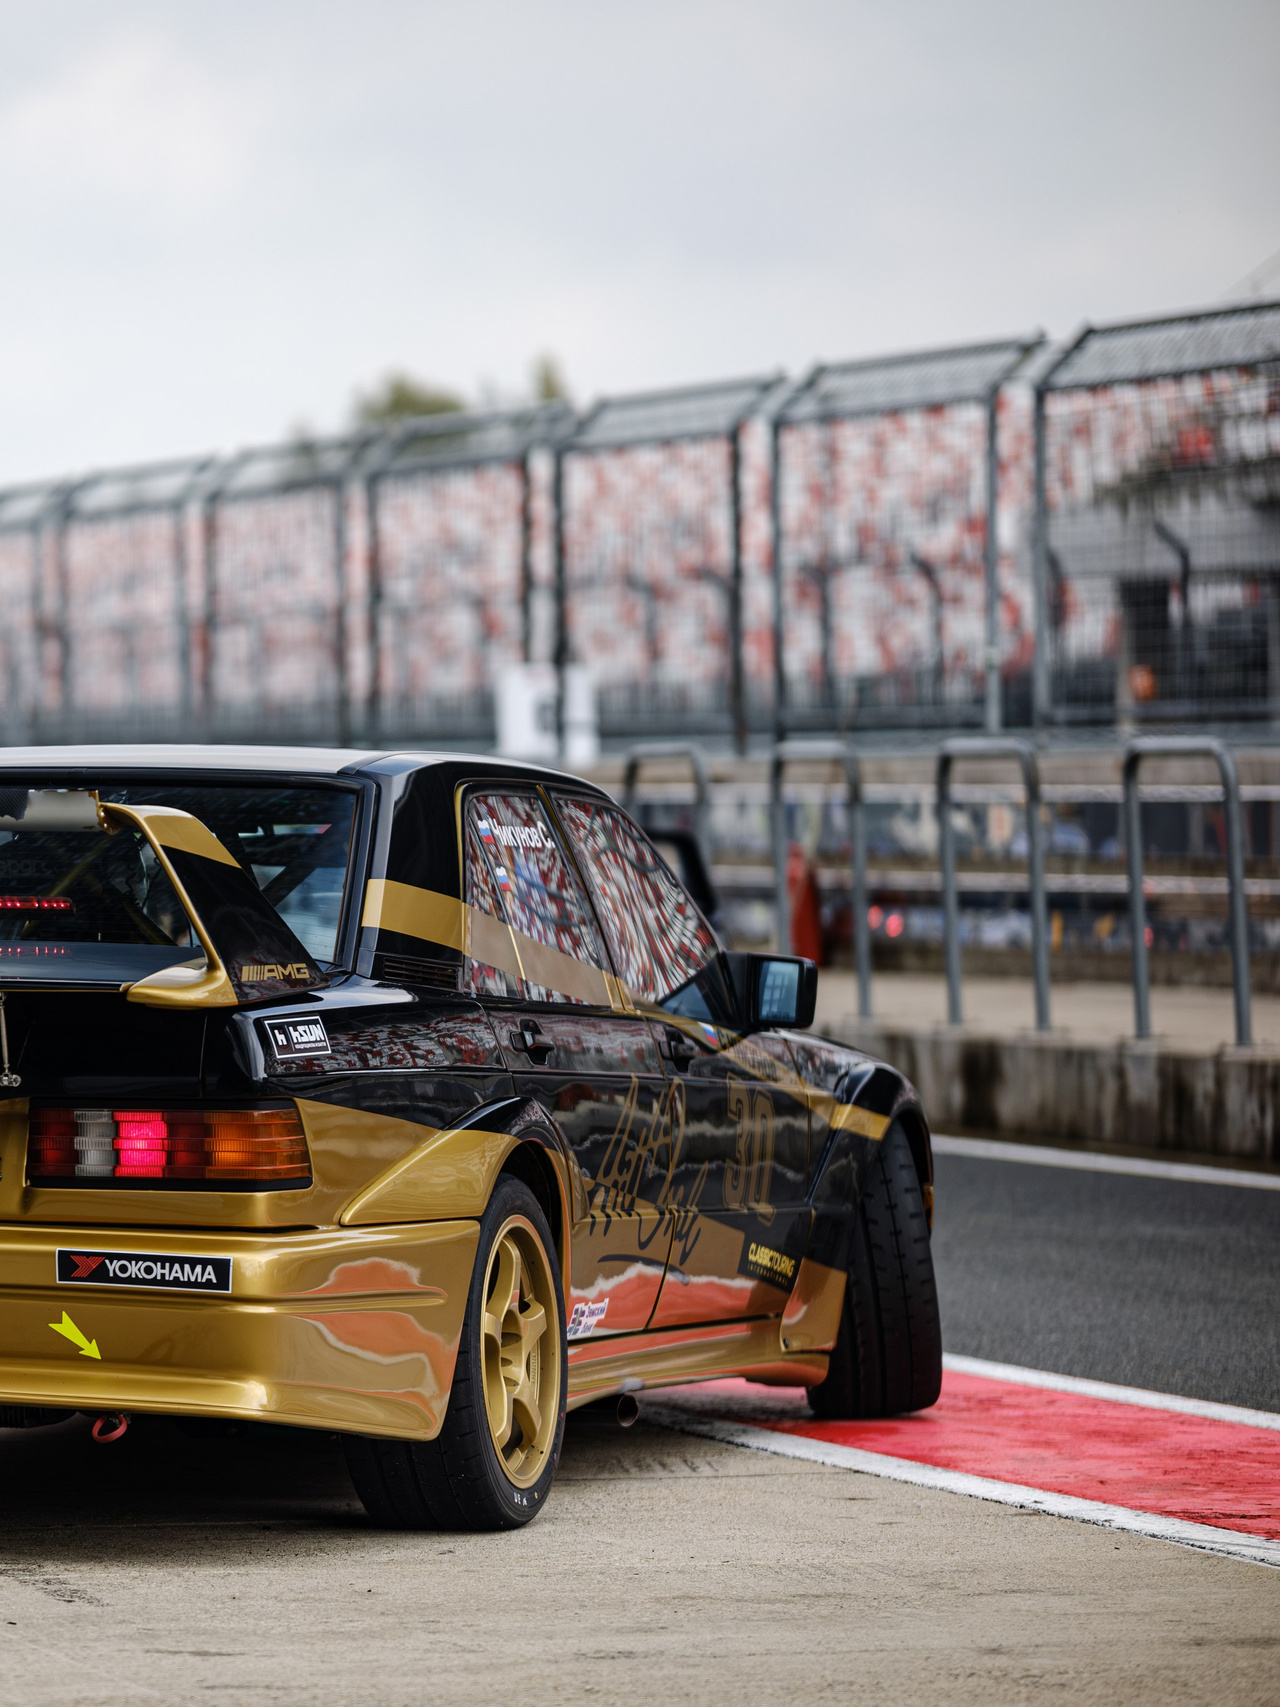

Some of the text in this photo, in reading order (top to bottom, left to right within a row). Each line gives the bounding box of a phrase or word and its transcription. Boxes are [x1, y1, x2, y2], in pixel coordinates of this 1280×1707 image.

[263, 963, 310, 981] AMG
[722, 1072, 777, 1228] 30
[104, 1259, 217, 1283] YOKOHAMA
